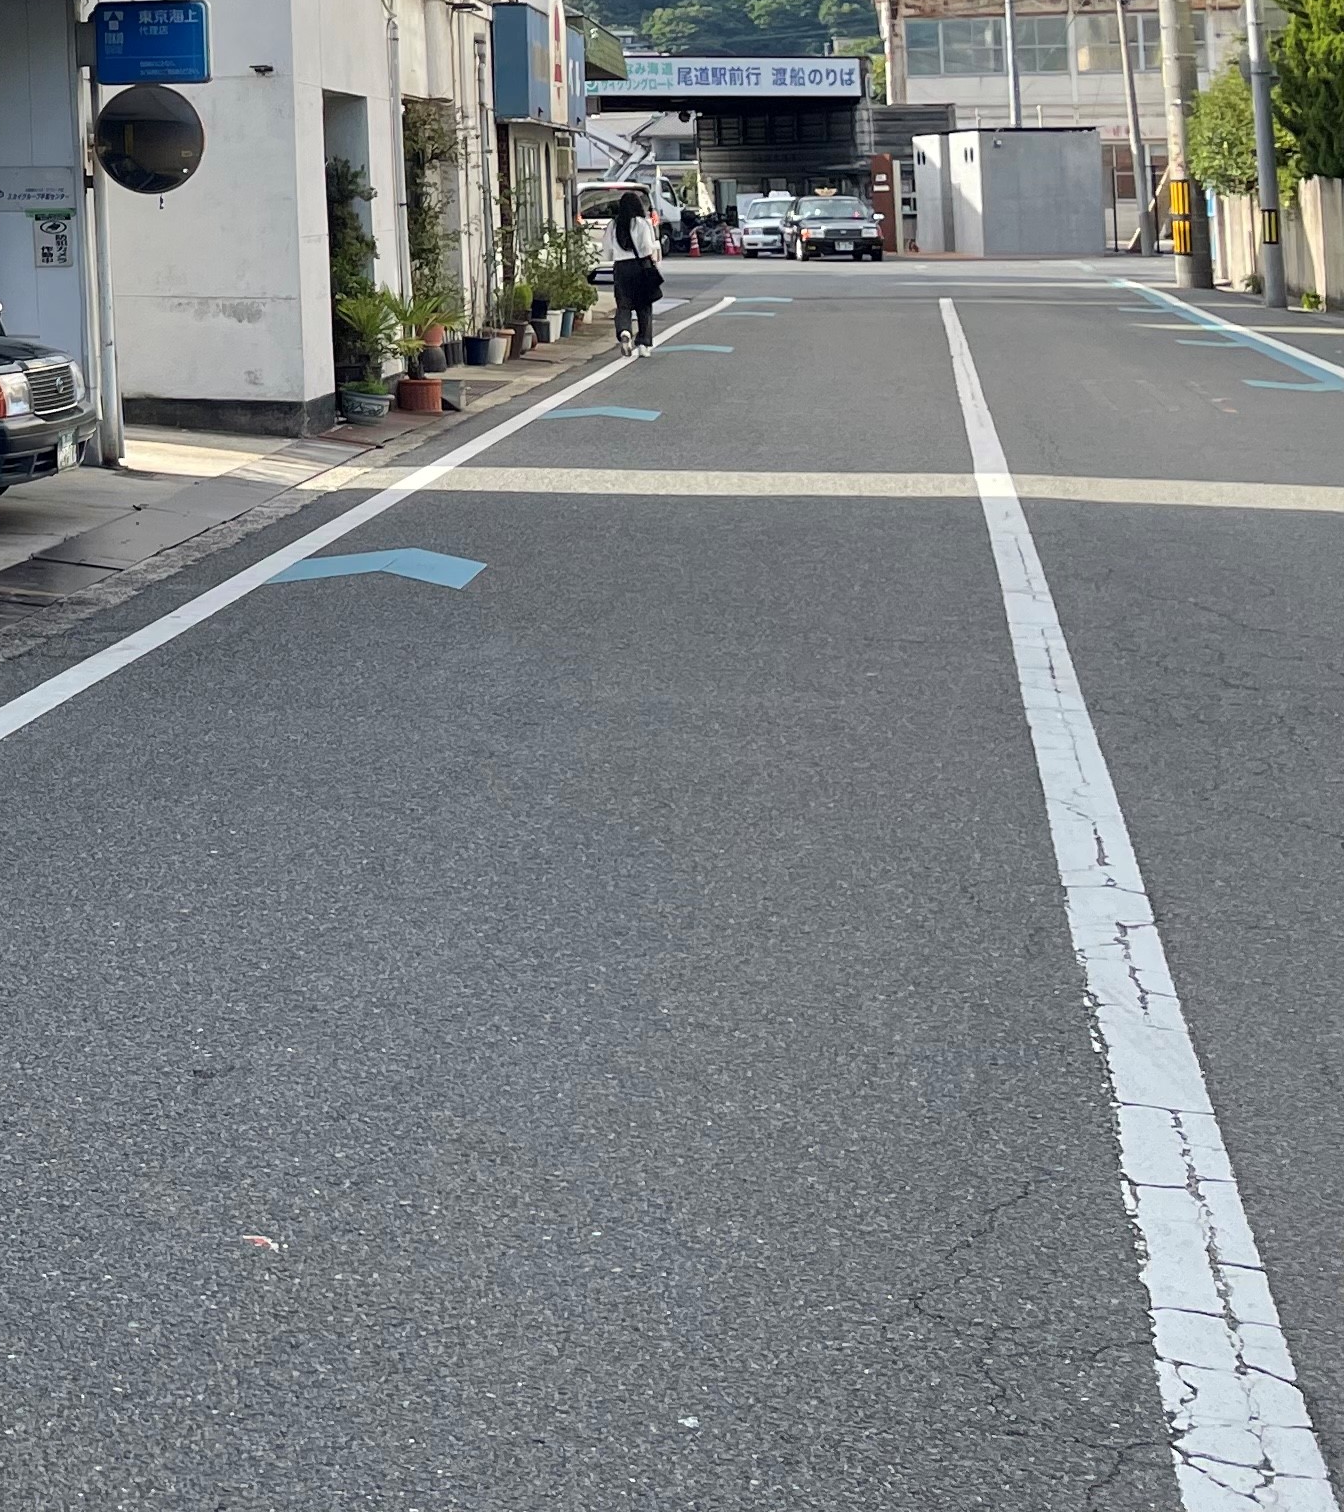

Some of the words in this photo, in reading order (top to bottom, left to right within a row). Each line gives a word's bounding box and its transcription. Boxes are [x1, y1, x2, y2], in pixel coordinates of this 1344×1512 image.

[139, 9, 199, 24] 東京海上
[139, 25, 169, 36] 代理店
[677, 66, 761, 86] 尾道駅前行
[772, 67, 855, 86] 渡船のりば
